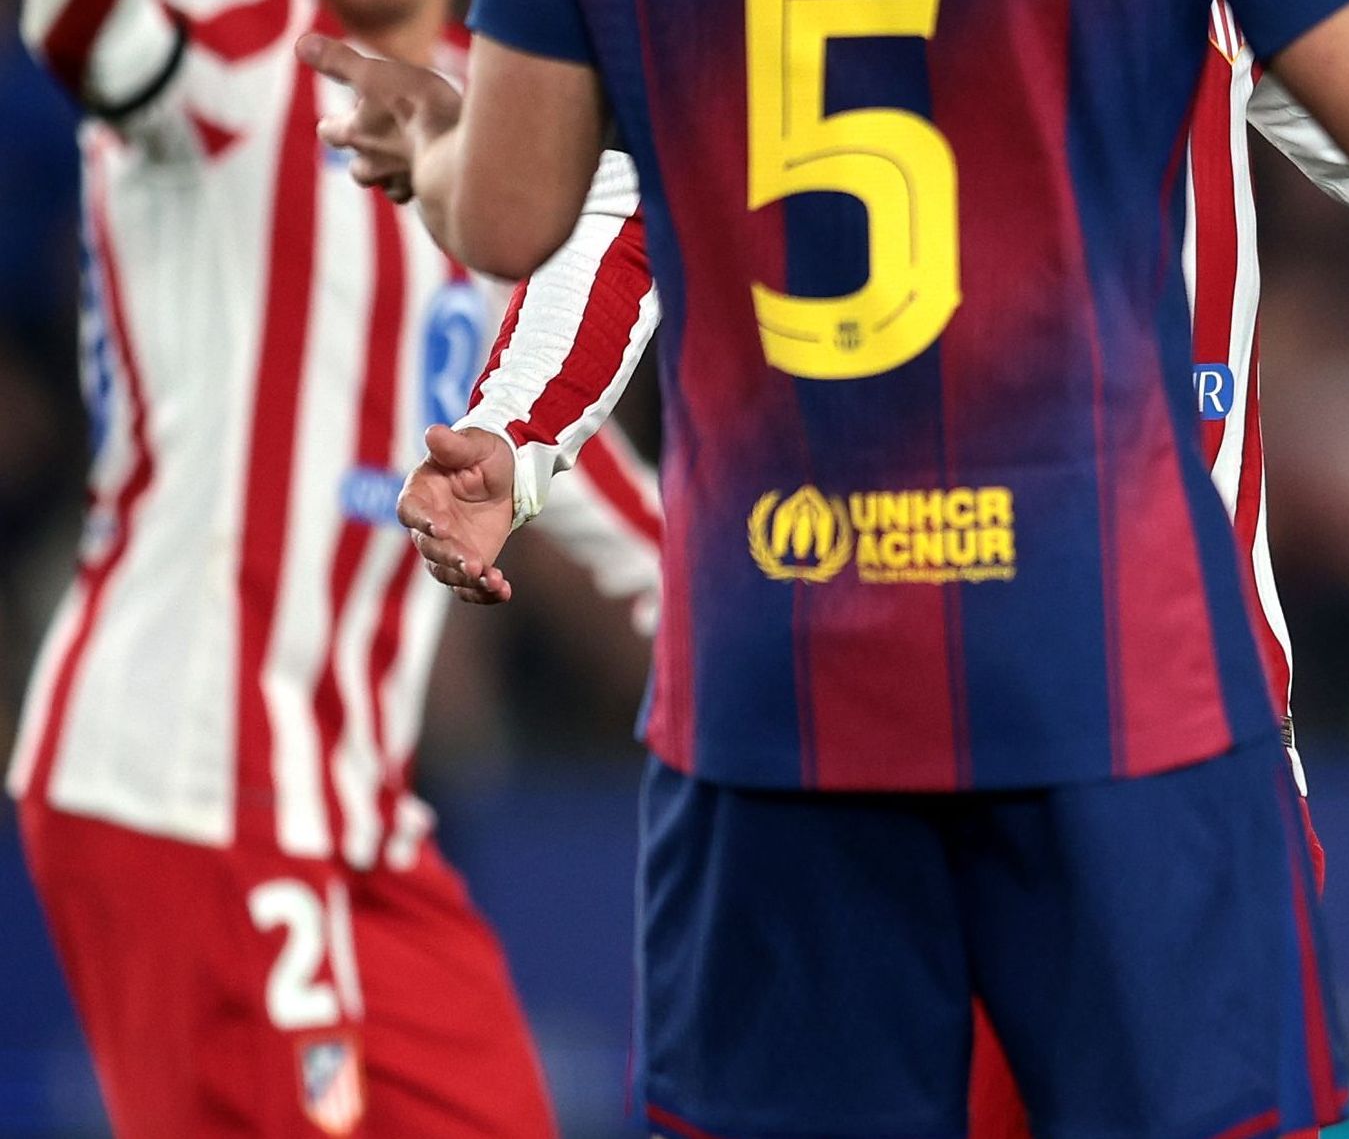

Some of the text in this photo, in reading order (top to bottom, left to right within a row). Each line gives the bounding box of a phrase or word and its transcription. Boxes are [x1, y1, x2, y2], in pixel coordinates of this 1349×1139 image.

[1193, 371, 1225, 413] R
[850, 487, 1013, 531] UNHCR
[856, 527, 1014, 568] ACNUR
